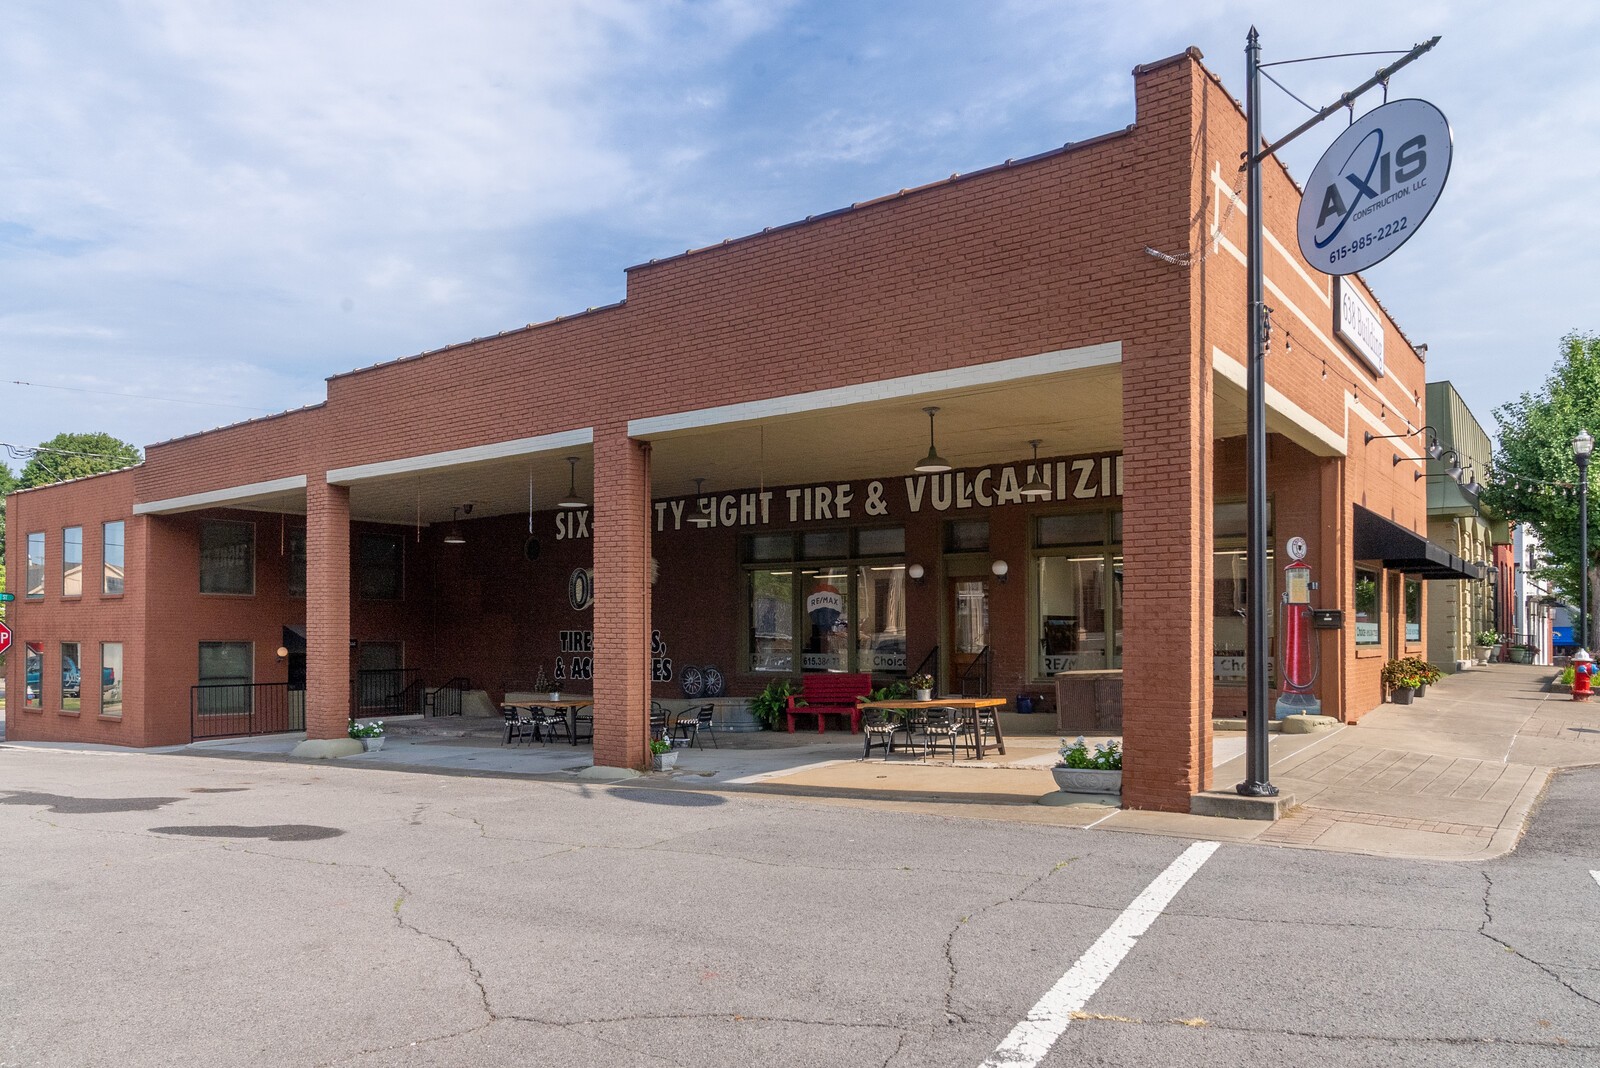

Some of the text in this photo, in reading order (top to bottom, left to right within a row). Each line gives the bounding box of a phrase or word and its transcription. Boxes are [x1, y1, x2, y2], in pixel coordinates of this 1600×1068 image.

[1316, 134, 1427, 229] AXIS
[1352, 177, 1427, 221] CONSTRUCTION, LLC
[1329, 216, 1408, 264] 615-985-2222
[1343, 292, 1356, 330] 638
[786, 484, 854, 522] TIRE
[865, 480, 888, 516] &
[811, 597, 839, 606] RE/MAX
[560, 630, 594, 653] TIRE
[554, 656, 566, 680] &
